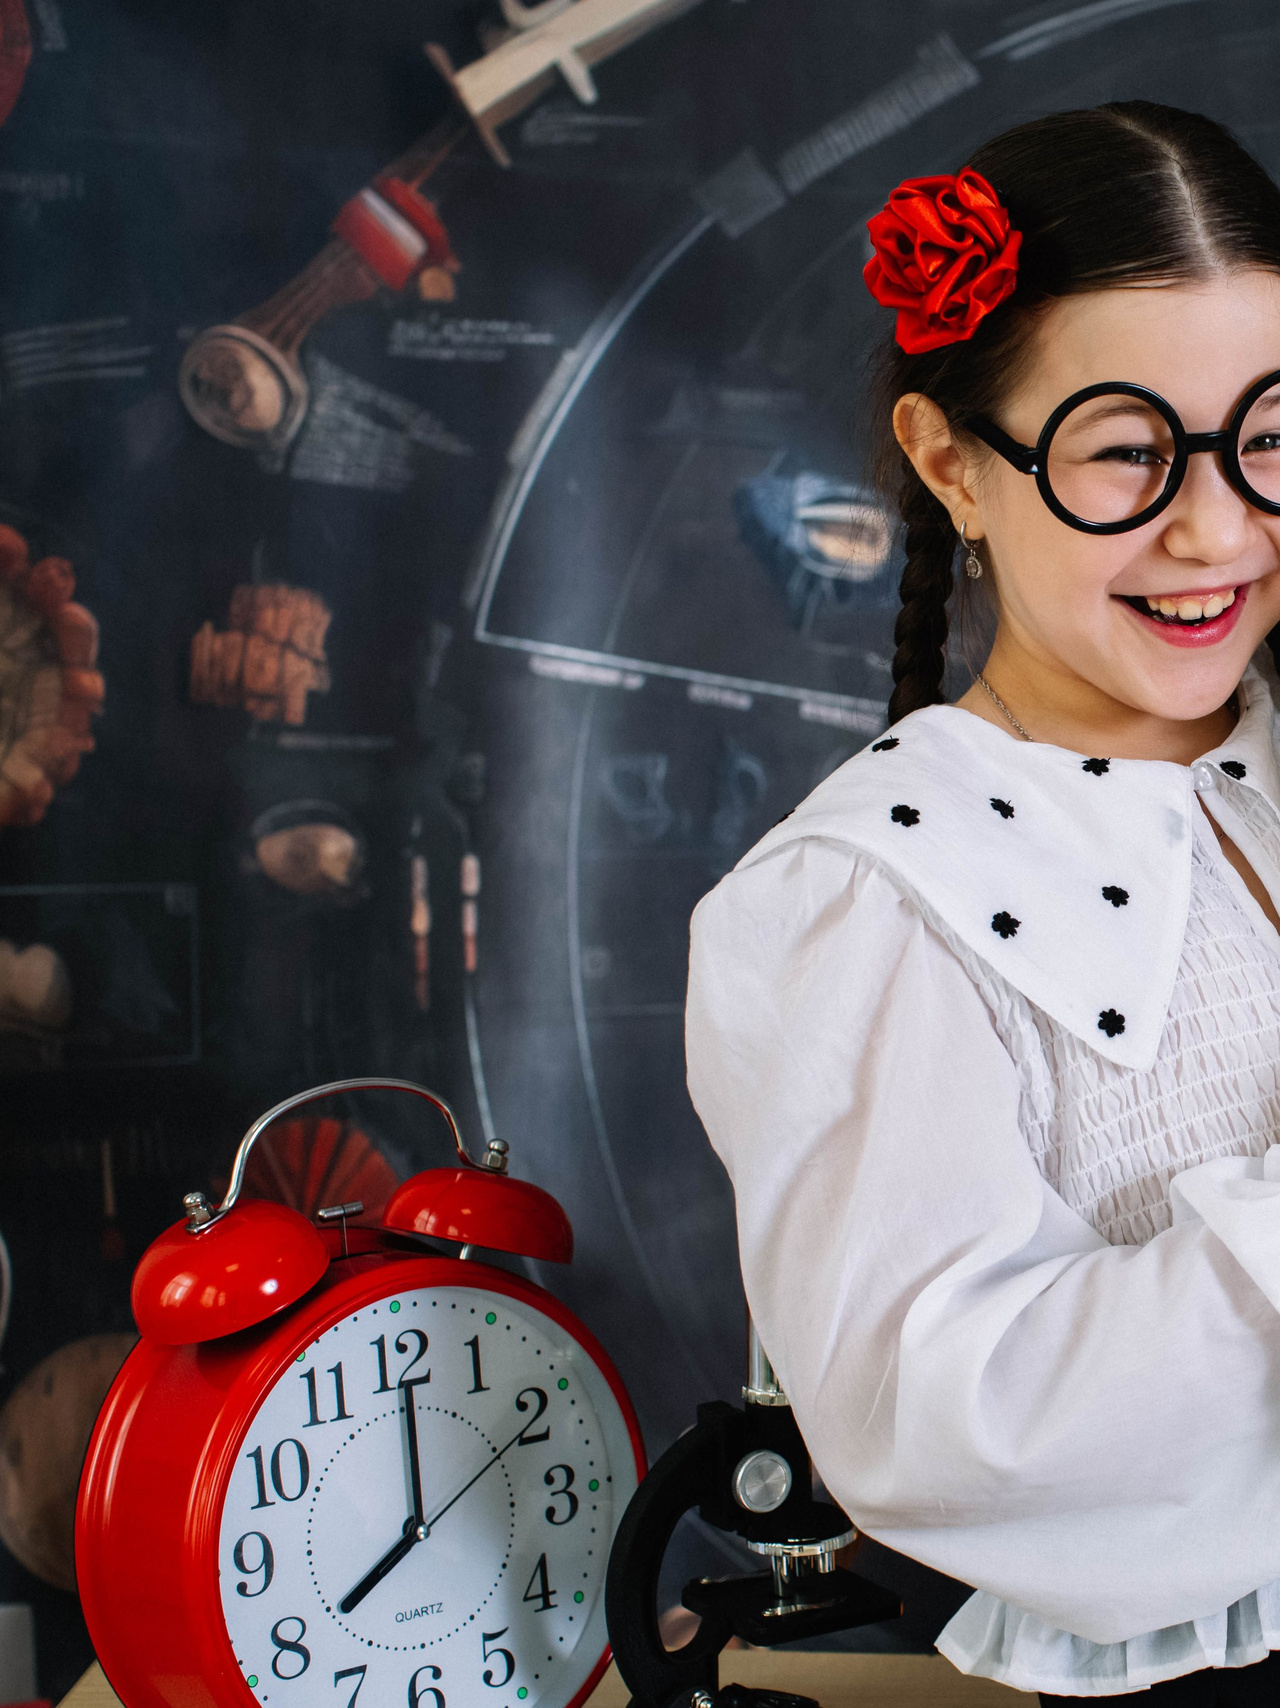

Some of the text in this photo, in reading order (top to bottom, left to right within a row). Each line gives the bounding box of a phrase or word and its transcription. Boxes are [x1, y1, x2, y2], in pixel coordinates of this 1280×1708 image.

[370, 1329, 430, 1394] 12
[464, 1335, 490, 1394] 1
[299, 1361, 354, 1428] 11
[514, 1387, 550, 1446] 2
[246, 1438, 310, 1510] 10
[544, 1464, 578, 1525] 3
[234, 1532, 274, 1597] 9
[523, 1553, 557, 1612] 4
[395, 1602, 443, 1623] QUARTZ
[271, 1617, 310, 1680] 8
[483, 1627, 515, 1687] 5
[335, 1664, 367, 1708] 7
[408, 1665, 445, 1708] 6
